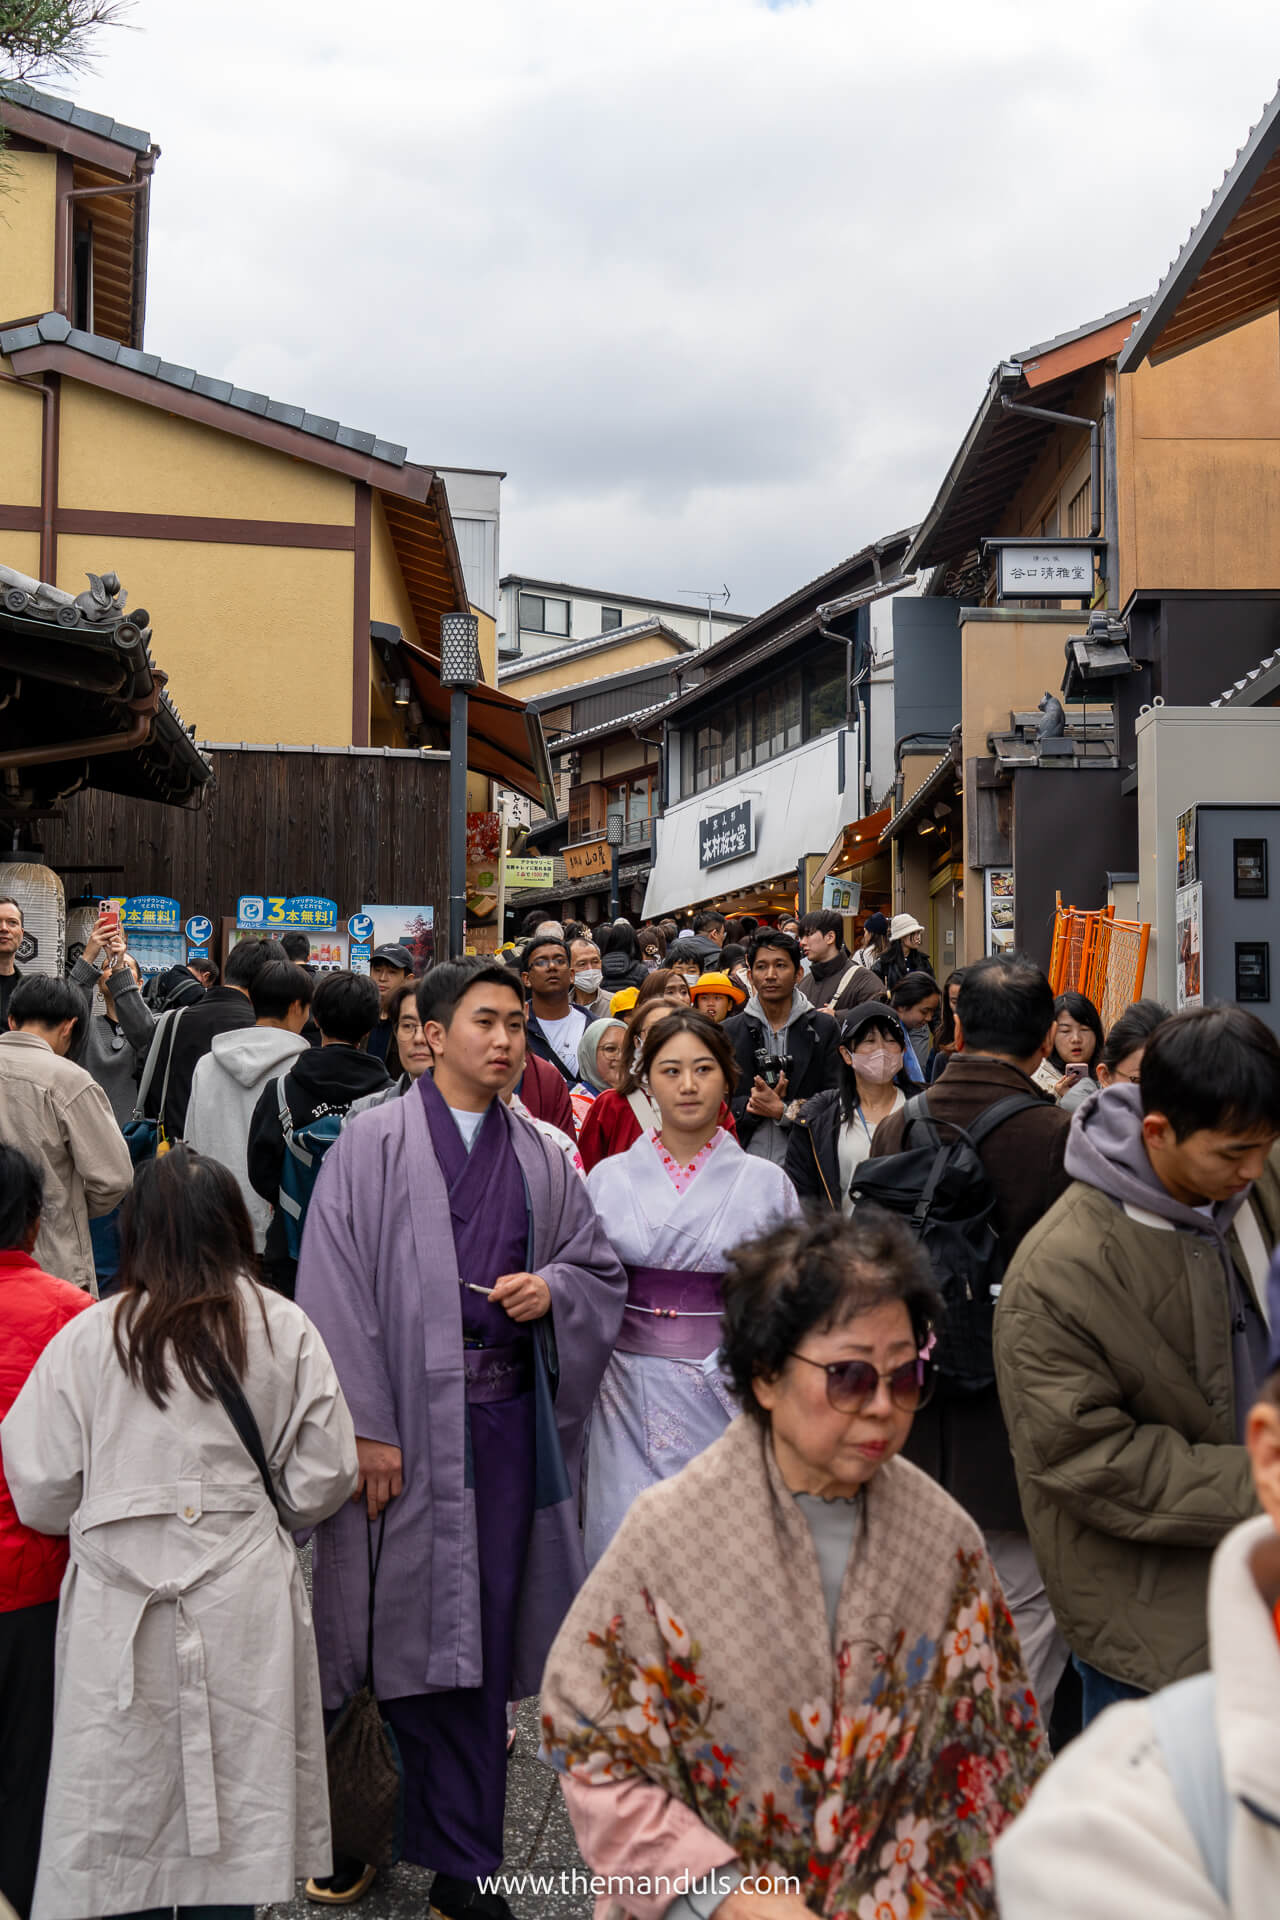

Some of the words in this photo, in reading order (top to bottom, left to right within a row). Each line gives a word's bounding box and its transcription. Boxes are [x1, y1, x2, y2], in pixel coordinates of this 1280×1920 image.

[1010, 566, 1085, 580] 谷口清雅堂
[267, 898, 333, 924] 3本無料!
[191, 919, 208, 938] ピ
[354, 918, 370, 936] ピ
